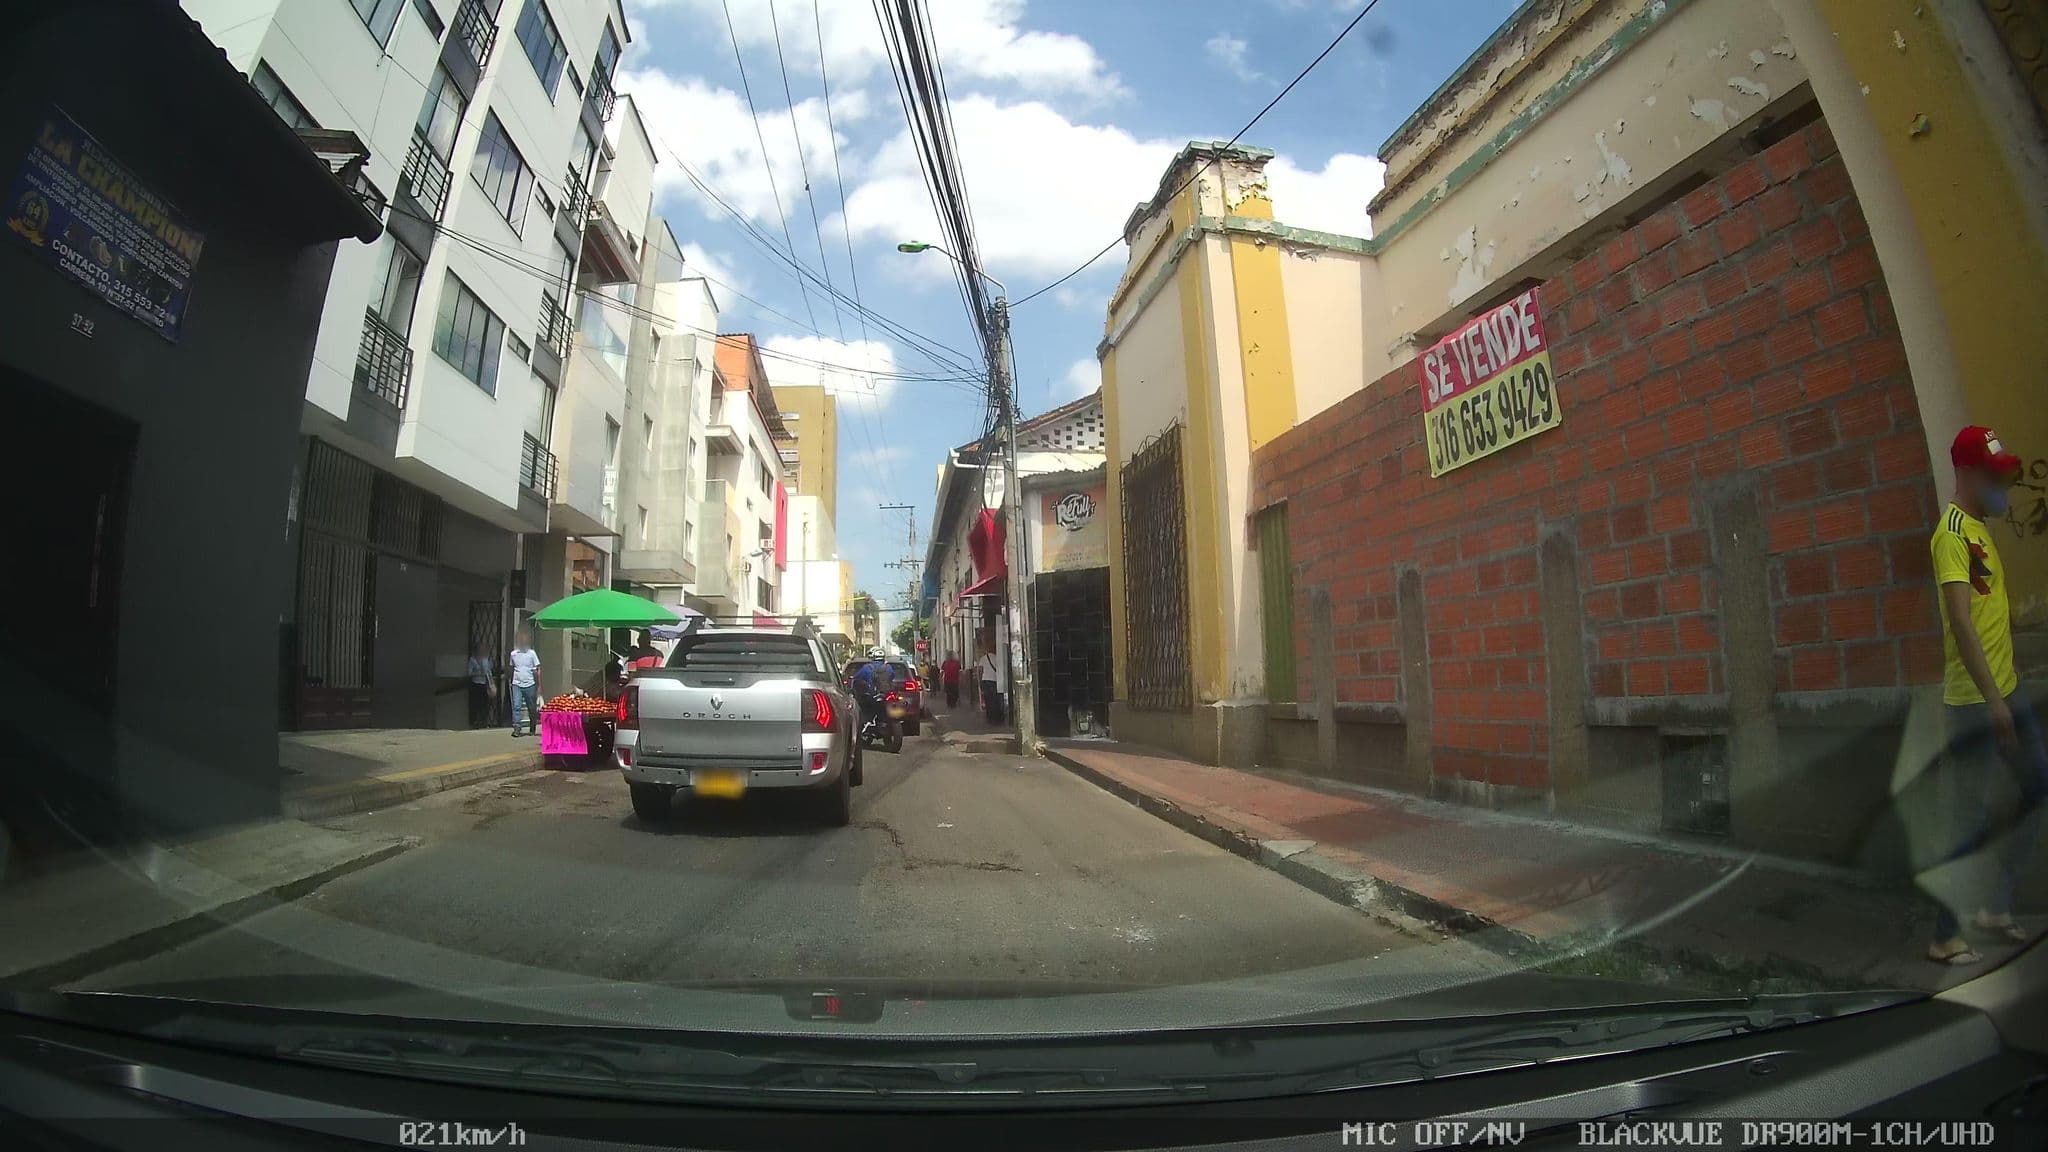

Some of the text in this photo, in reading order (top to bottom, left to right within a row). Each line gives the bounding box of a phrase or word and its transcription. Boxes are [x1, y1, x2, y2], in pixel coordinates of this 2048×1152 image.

[40, 116, 76, 168] LA
[58, 255, 97, 286] CARRERA
[112, 278, 133, 298] 315
[133, 291, 152, 311] 553
[1423, 291, 1541, 403] SE VENDE
[1431, 362, 1553, 470] 316 653 9429
[683, 711, 751, 720] OROCH
